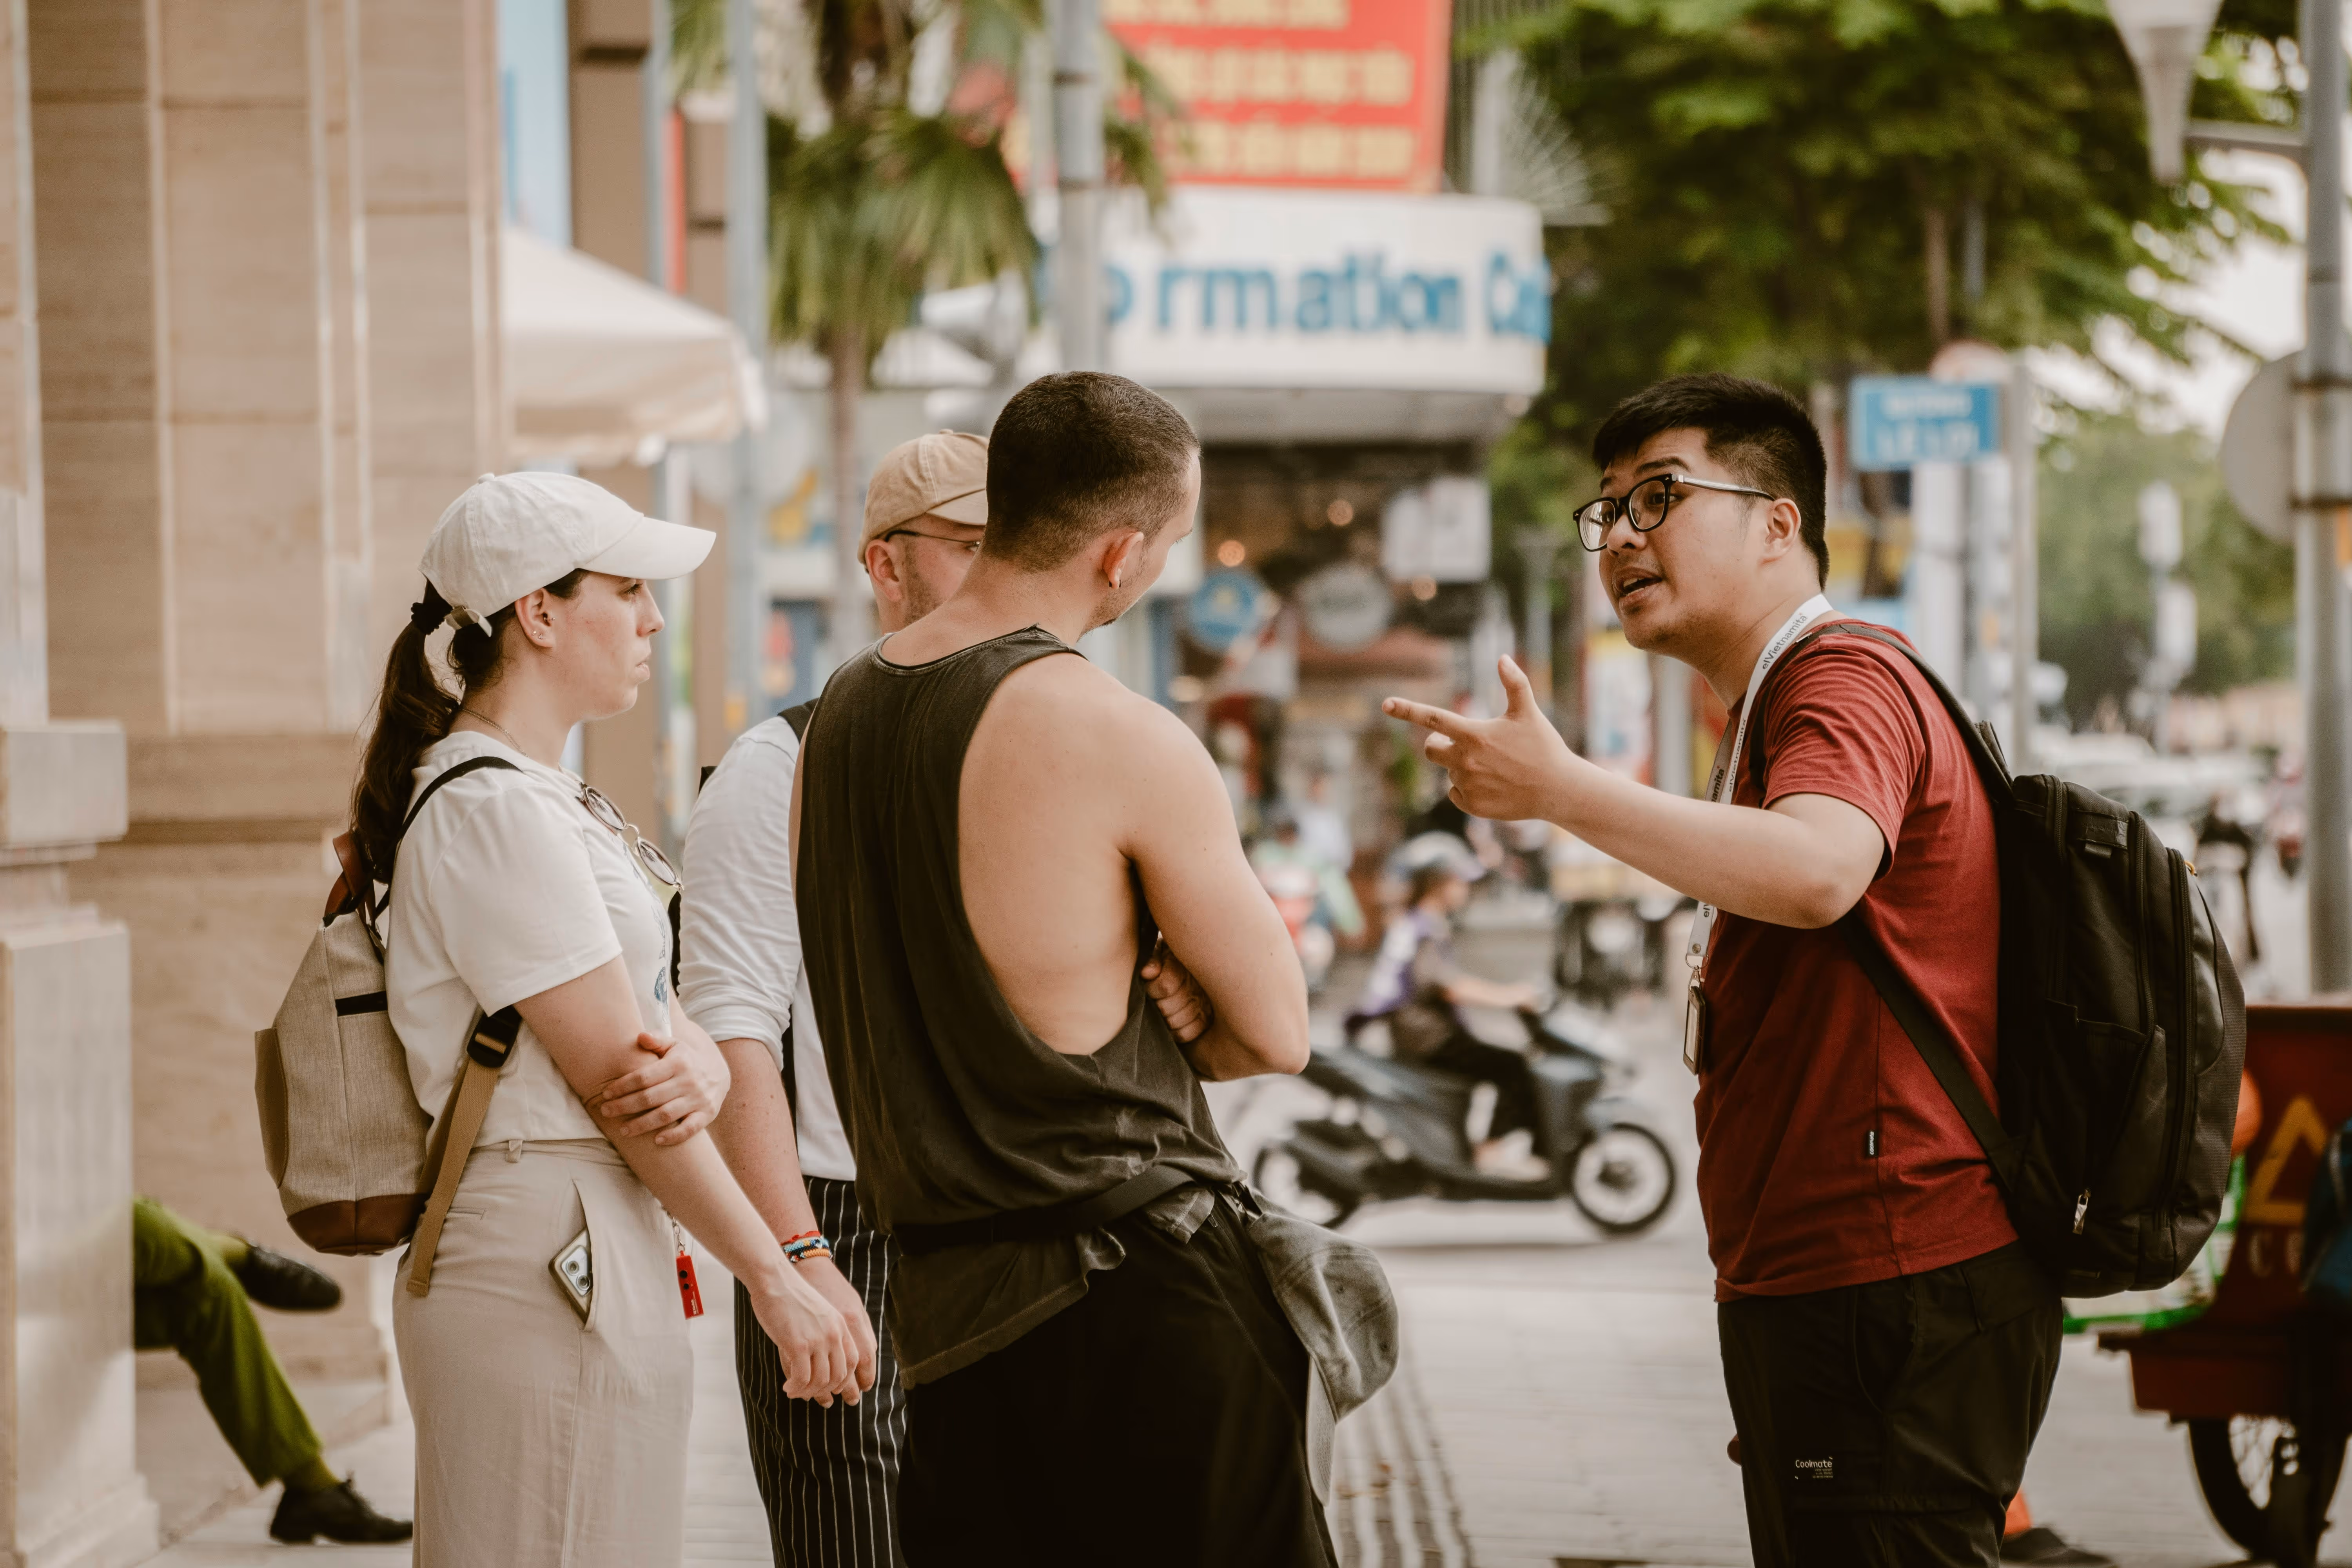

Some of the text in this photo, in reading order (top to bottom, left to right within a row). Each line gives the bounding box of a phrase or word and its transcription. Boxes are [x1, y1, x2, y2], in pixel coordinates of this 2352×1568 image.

[1102, 251, 1464, 331] ormation
[1762, 615, 1808, 670] elVietnamita
[1729, 719, 1746, 793] elVietnamita
[1795, 1460, 1832, 1468] Coolmate
